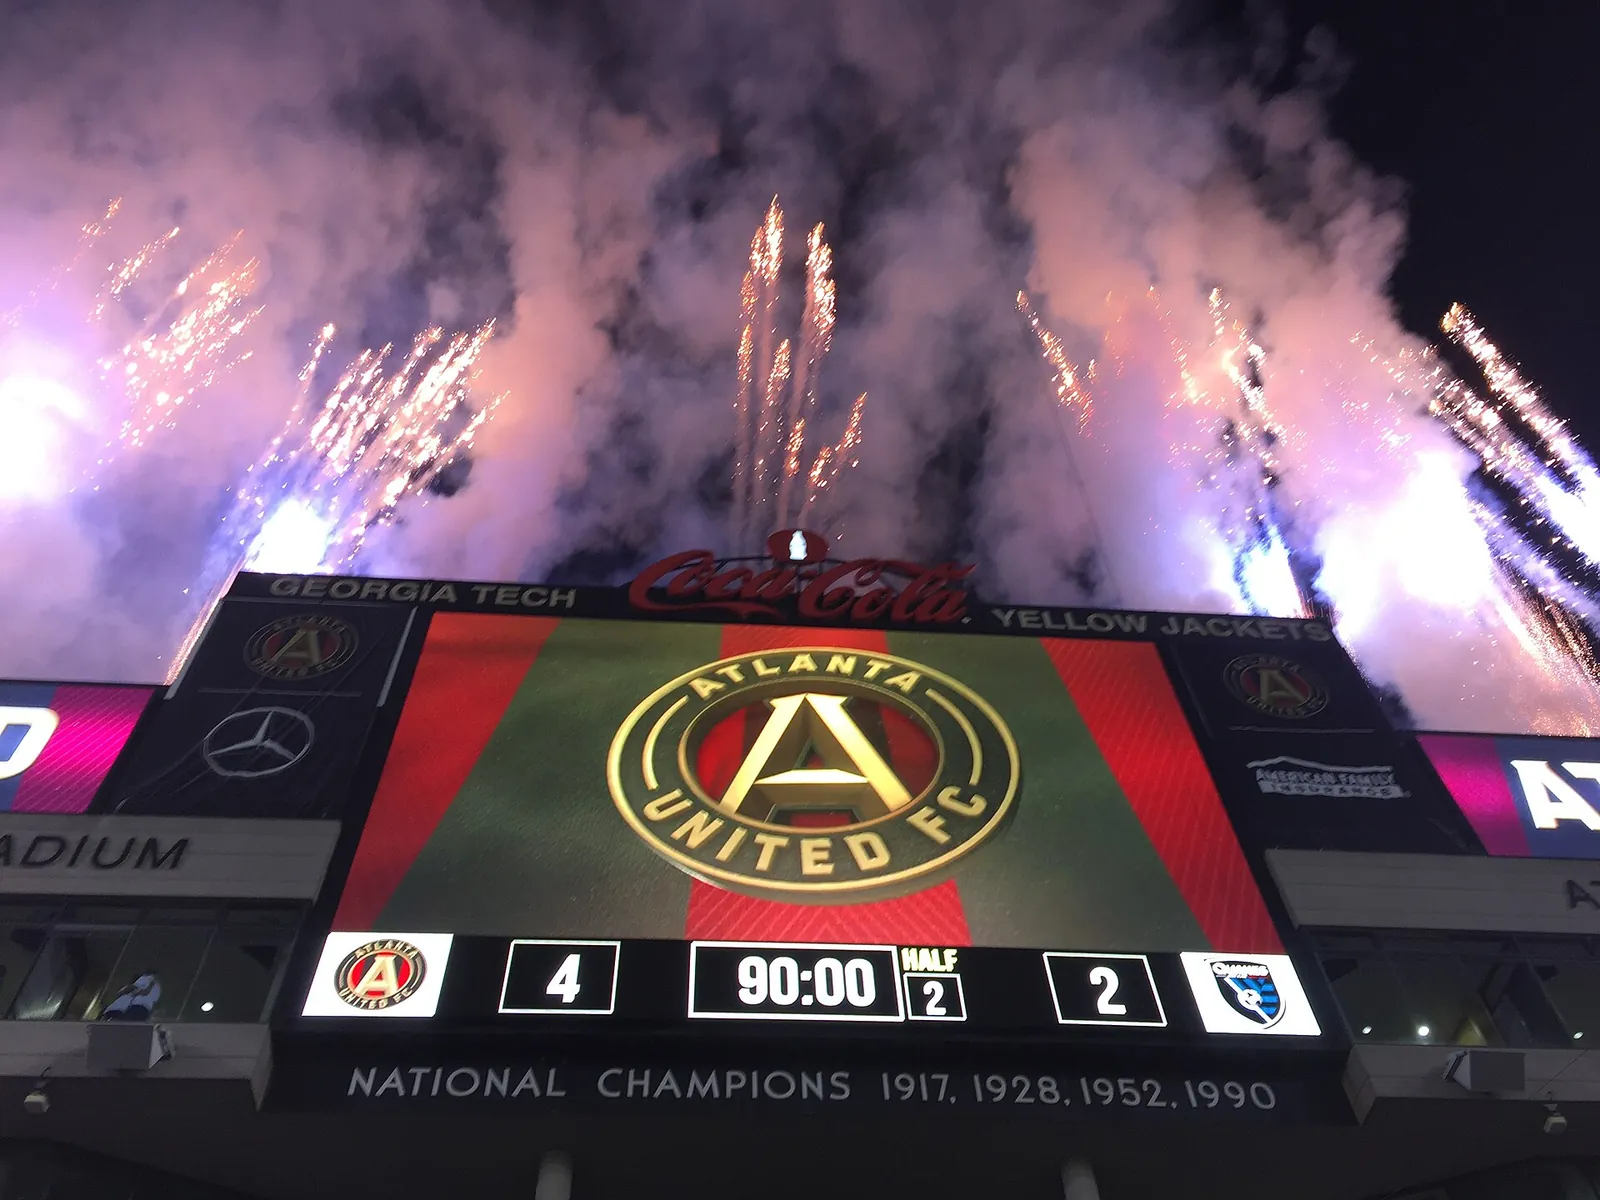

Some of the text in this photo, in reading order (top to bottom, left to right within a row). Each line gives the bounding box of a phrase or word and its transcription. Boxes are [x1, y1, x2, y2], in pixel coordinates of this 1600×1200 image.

[269, 576, 577, 609] GEORGIA TECH
[628, 549, 978, 624] Coca-Cola
[990, 608, 1333, 642] YELLOW JACKETS
[688, 653, 927, 700] ATLANTA
[717, 692, 915, 824] A
[642, 784, 988, 876] UNITED FC
[1564, 879, 1600, 911] A
[354, 939, 420, 959] ATLANTA
[901, 947, 958, 972] HALF
[338, 986, 388, 1010] UNITED
[545, 953, 582, 1003] 4
[738, 955, 876, 1007] 90:00
[922, 980, 947, 1016] 2
[1089, 966, 1127, 1015] 2
[347, 1066, 1277, 1111] NATIONAL CHAMPIONS 1917, 1928, 1952, 1990
